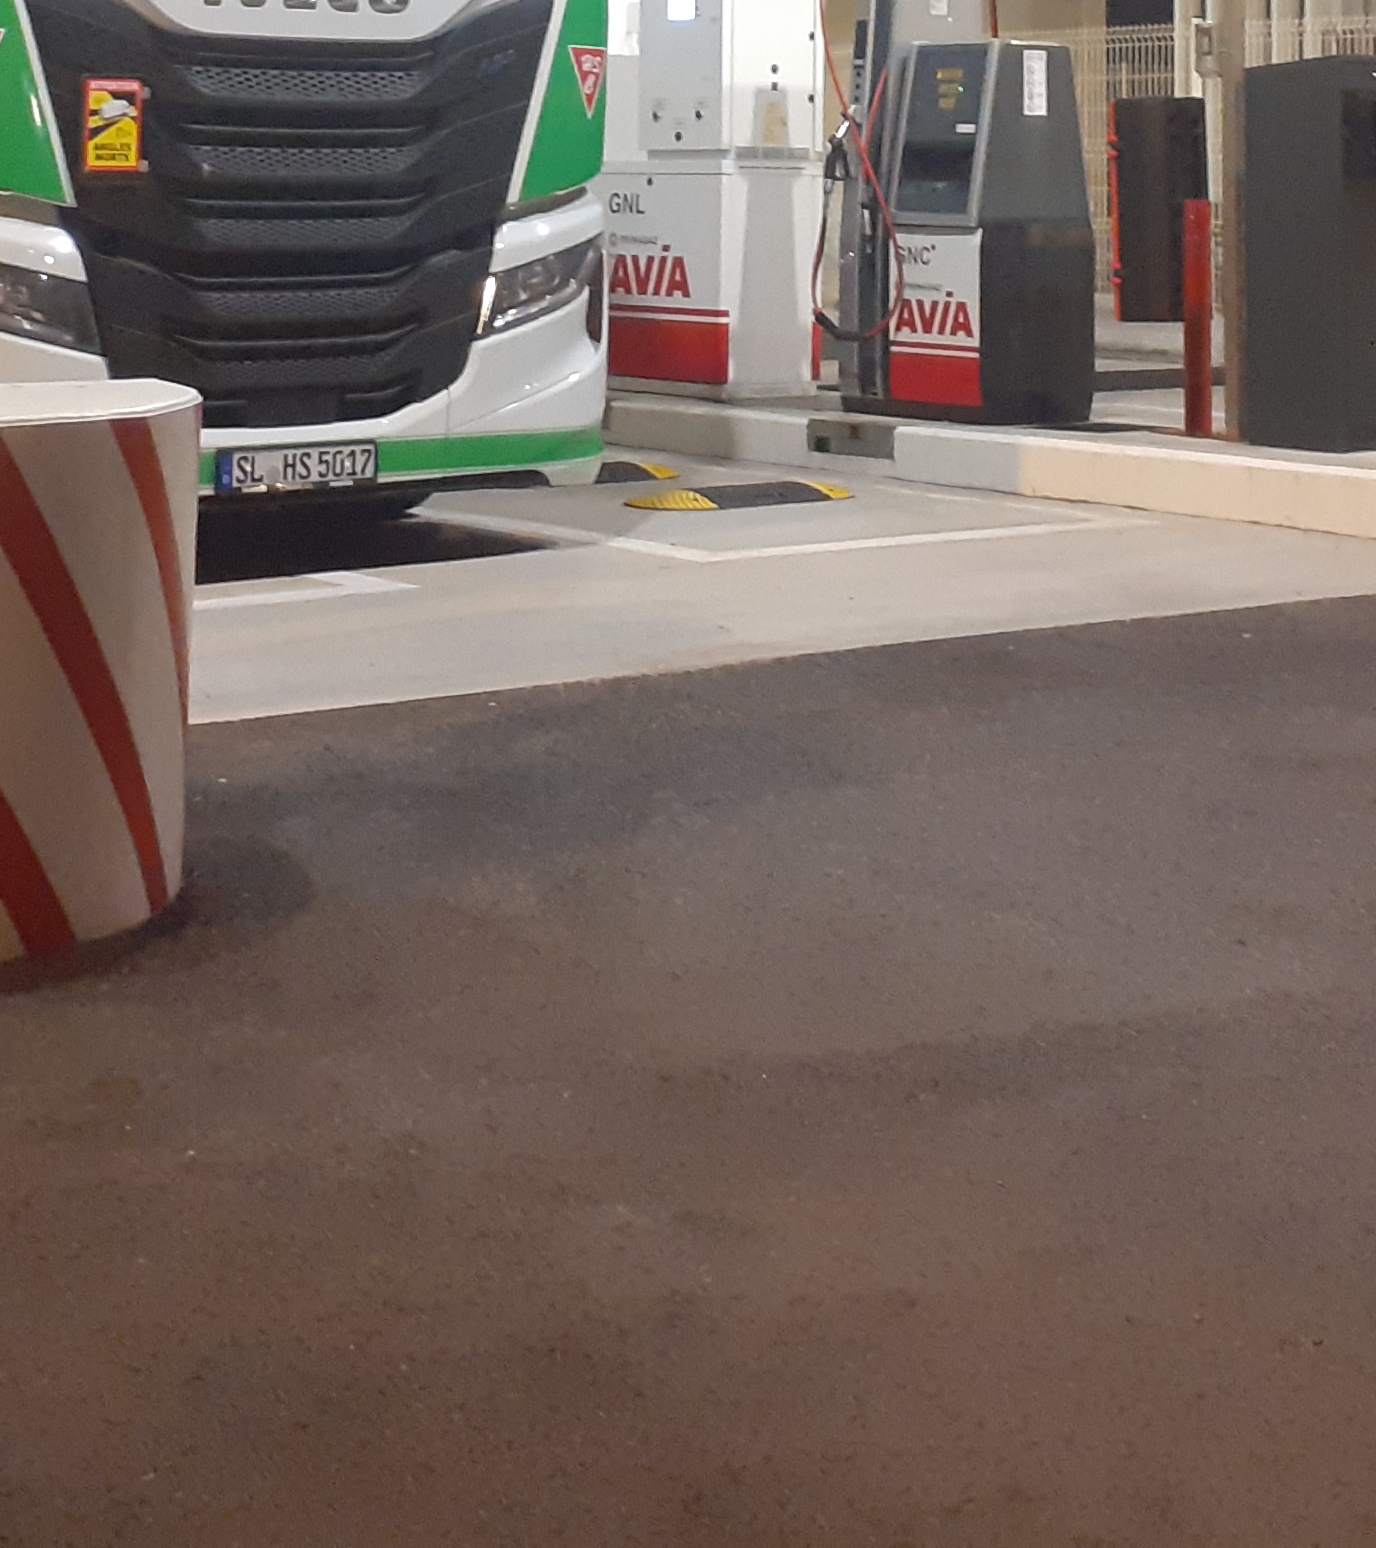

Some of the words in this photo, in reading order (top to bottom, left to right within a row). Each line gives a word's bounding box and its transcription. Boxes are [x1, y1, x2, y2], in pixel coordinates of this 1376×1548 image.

[608, 192, 645, 214] GNL
[235, 455, 264, 485] SL
[282, 451, 312, 480] HS
[317, 448, 373, 478] 5017
